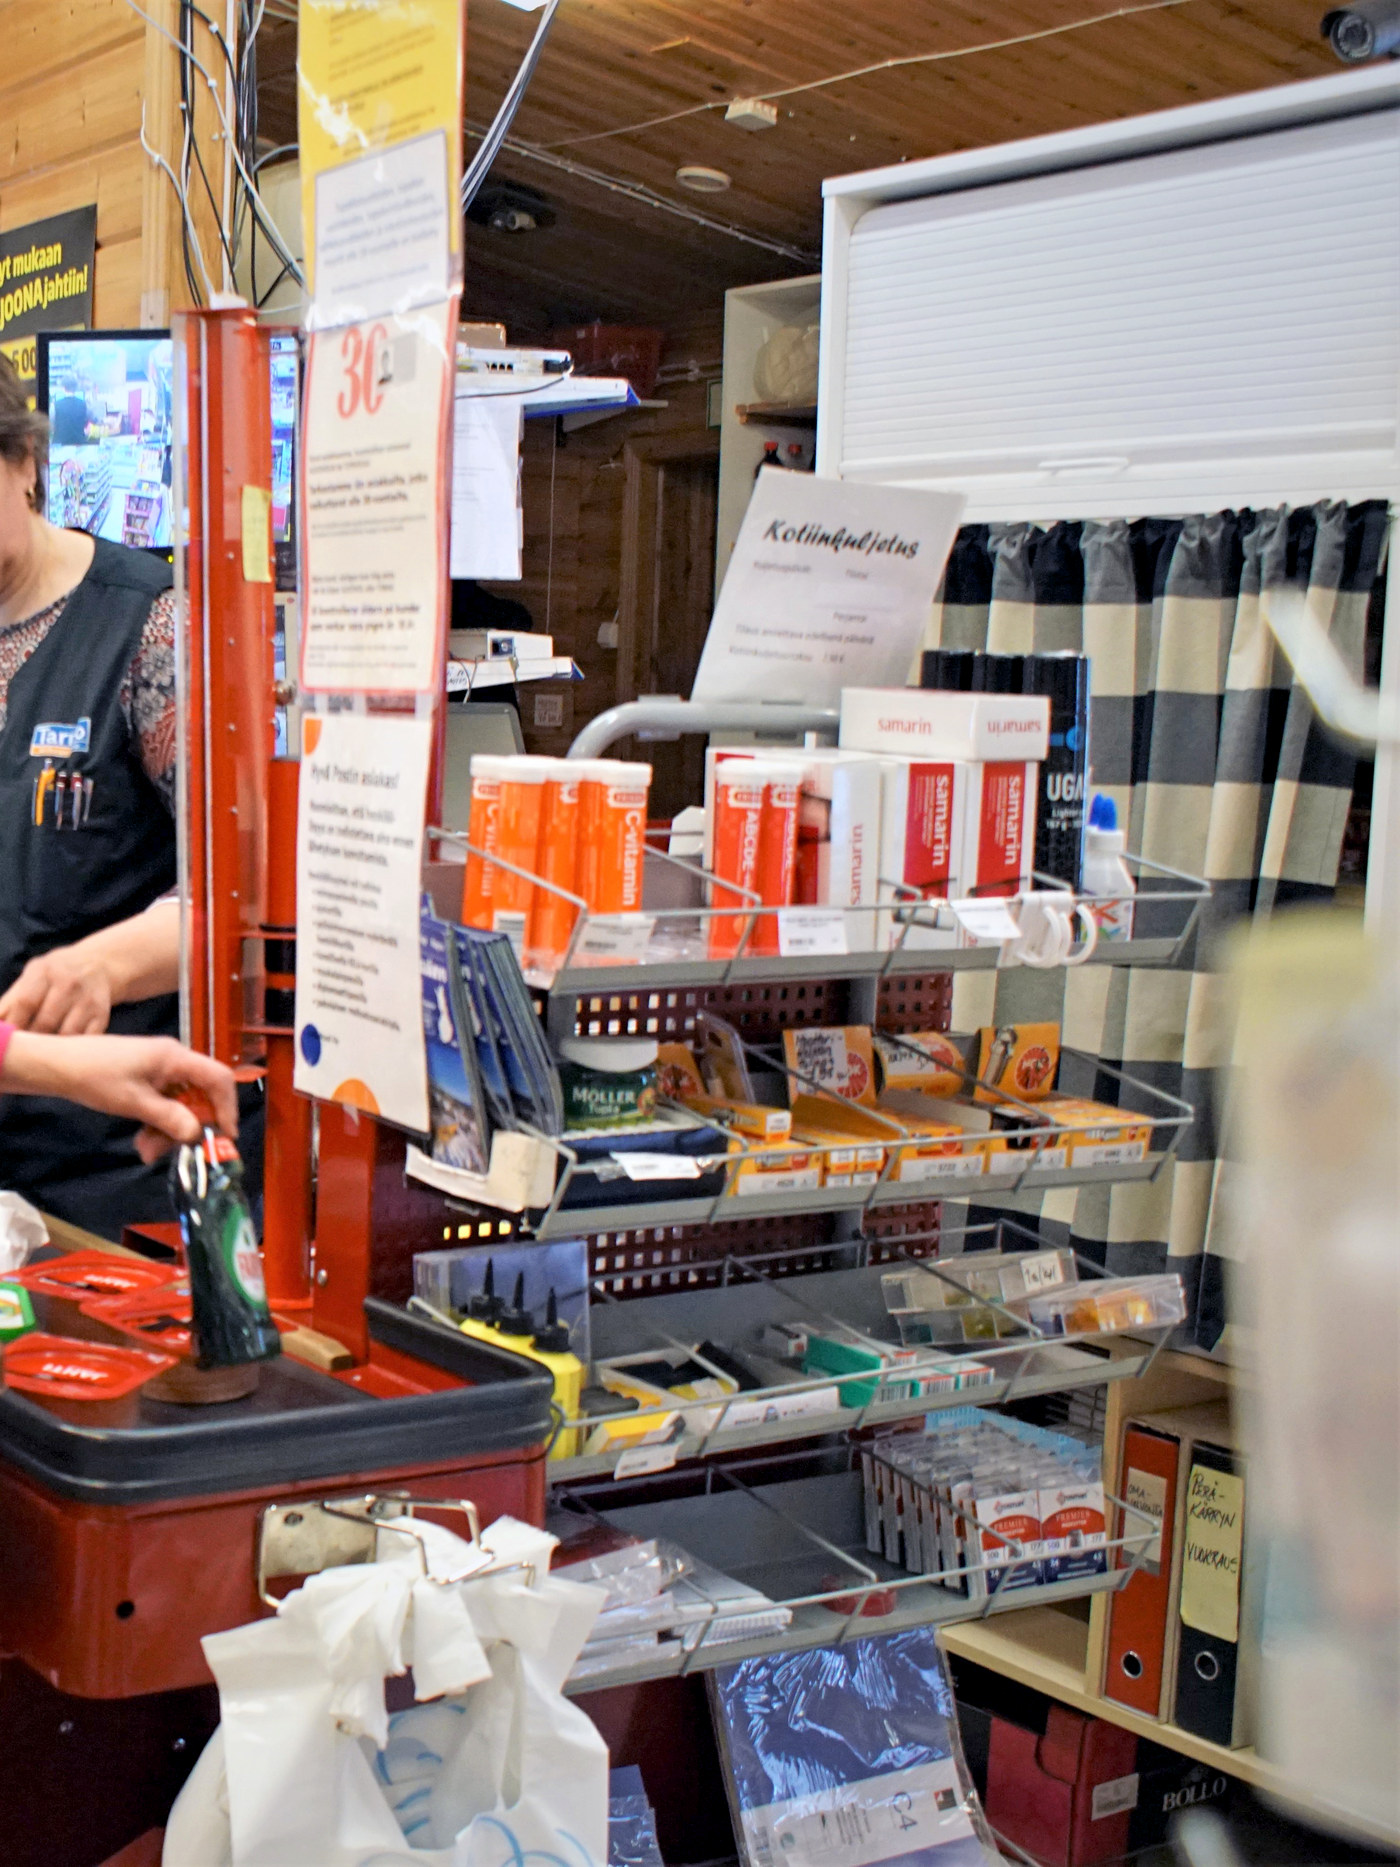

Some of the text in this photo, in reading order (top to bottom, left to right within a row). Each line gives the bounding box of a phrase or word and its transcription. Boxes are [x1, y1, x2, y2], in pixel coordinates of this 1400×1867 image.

[13, 242, 63, 278] mukaan
[763, 518, 920, 560] Kotiinkuljetus
[877, 717, 932, 735] samarin
[987, 720, 1042, 738] samarin
[933, 774, 950, 867] samarin
[1005, 774, 1021, 866] samarin
[622, 810, 641, 906] C-vitamin
[851, 823, 864, 906] samarin
[1056, 1510, 1091, 1523] PREMIER
[892, 1791, 918, 1832] C4
[1162, 1776, 1228, 1812] BOLLO
